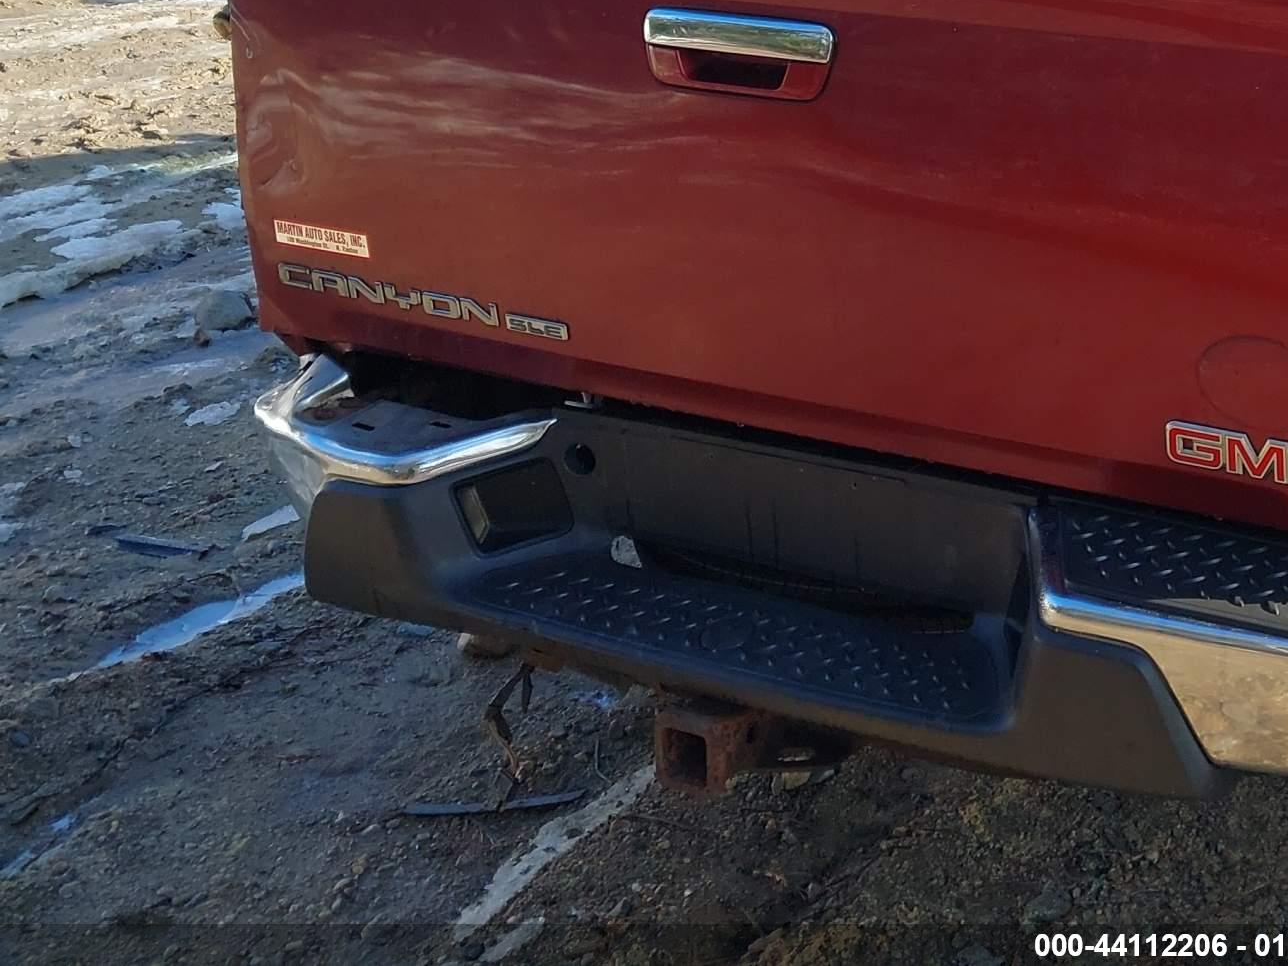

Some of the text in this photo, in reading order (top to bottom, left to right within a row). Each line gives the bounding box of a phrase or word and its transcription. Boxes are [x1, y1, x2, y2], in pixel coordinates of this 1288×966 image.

[277, 222, 303, 236] MARTIN
[305, 227, 323, 240] AUTO
[324, 230, 349, 247] SALES,
[349, 234, 366, 248] INC.
[277, 261, 565, 340] CANYON SLE
